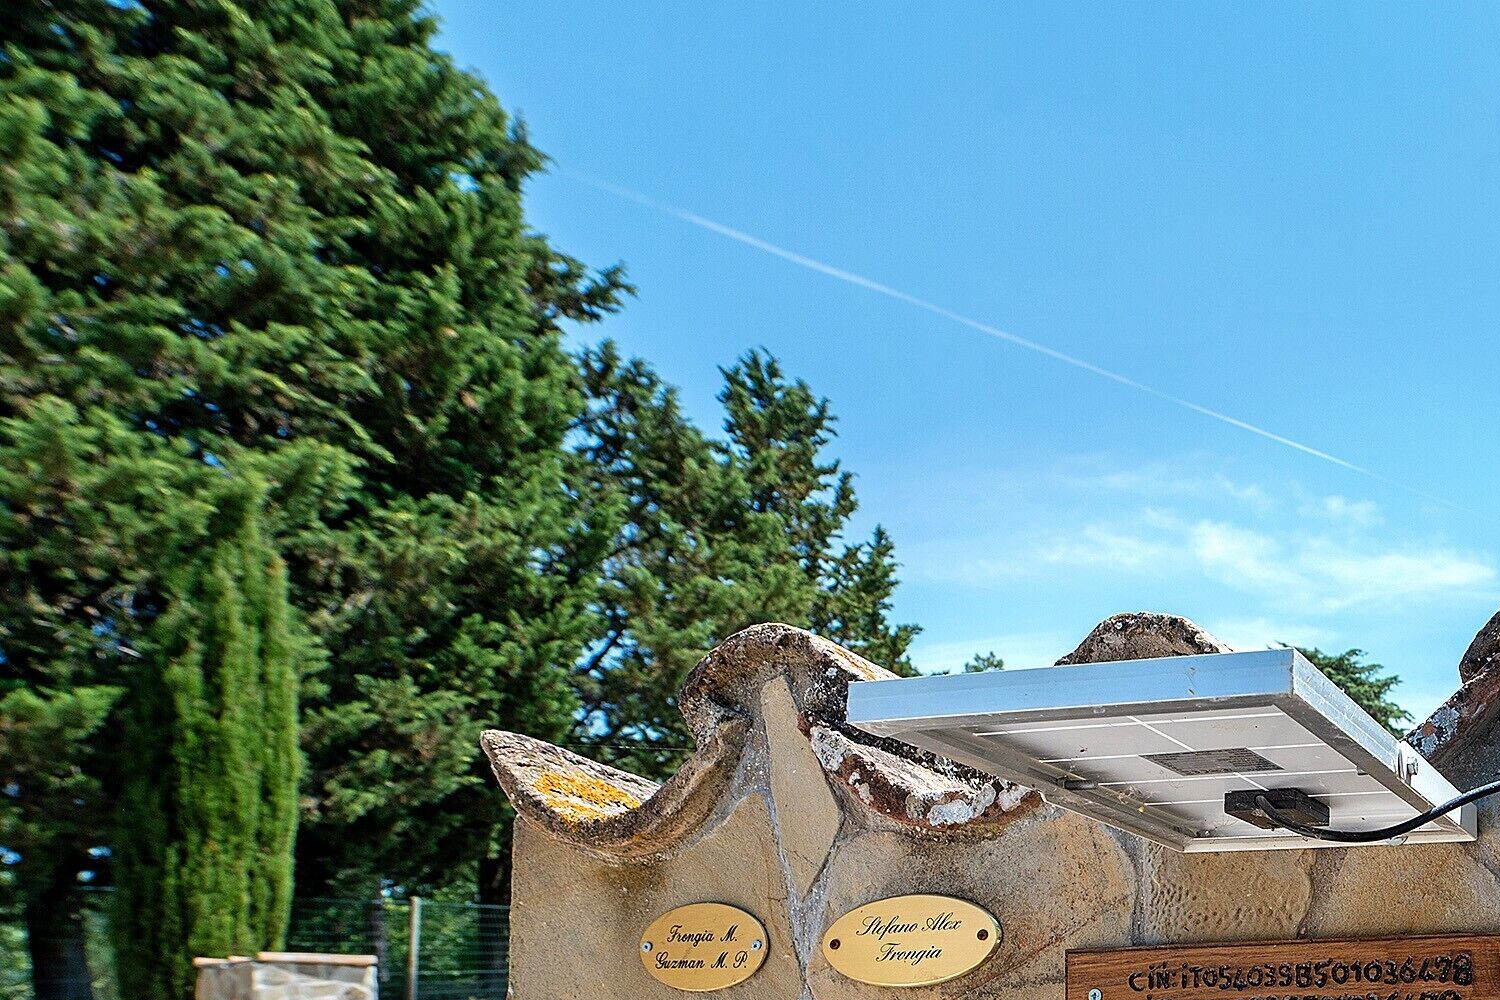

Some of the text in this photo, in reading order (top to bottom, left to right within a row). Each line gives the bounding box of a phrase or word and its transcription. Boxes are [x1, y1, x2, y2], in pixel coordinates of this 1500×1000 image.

[667, 925, 738, 948] Frongia M.
[856, 912, 962, 940] Stefano Alex
[655, 951, 748, 969] Guzman M. P.
[876, 942, 942, 966] Frongia
